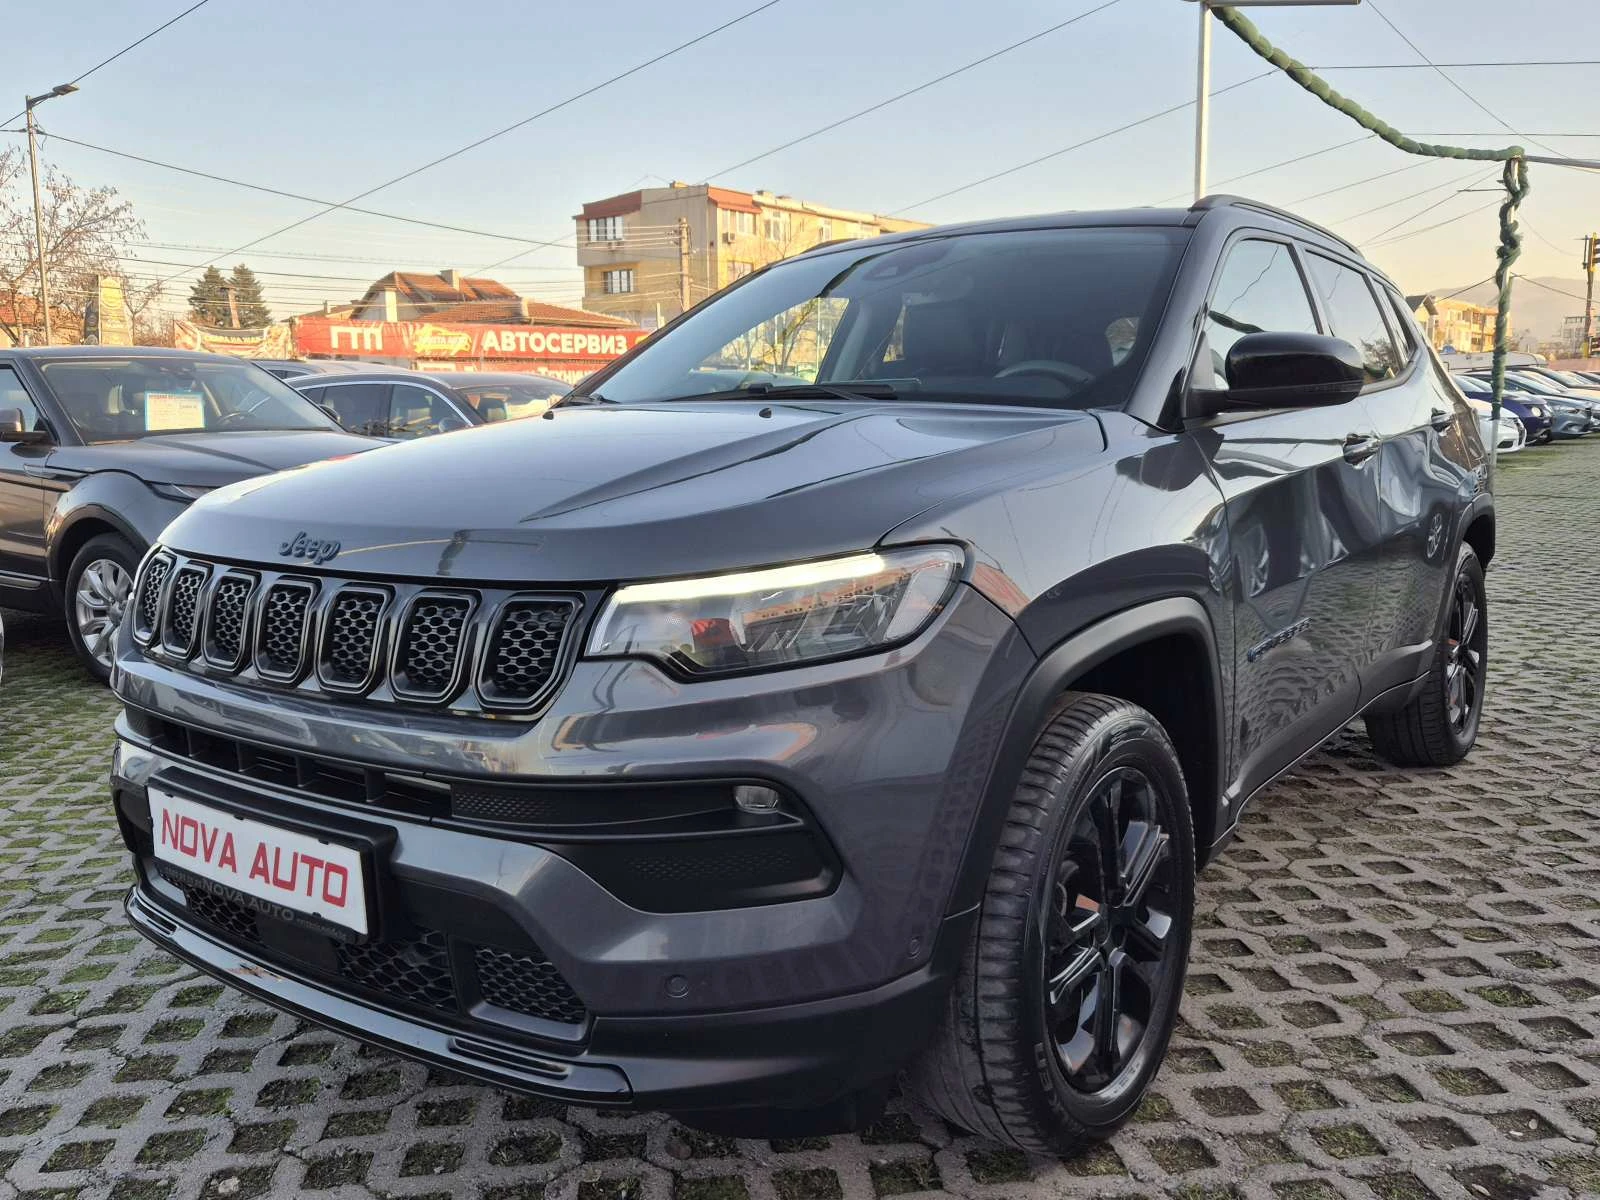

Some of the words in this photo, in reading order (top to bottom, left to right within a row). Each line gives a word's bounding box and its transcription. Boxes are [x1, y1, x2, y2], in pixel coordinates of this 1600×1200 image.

[328, 325, 384, 350] ГТП
[482, 330, 628, 355] АВТОСЕРВИЗ
[279, 530, 341, 565] Jeep
[162, 808, 238, 873] NOVA
[249, 842, 348, 908] AUTO
[203, 879, 245, 905] NOVA
[249, 897, 294, 921] AUTO
